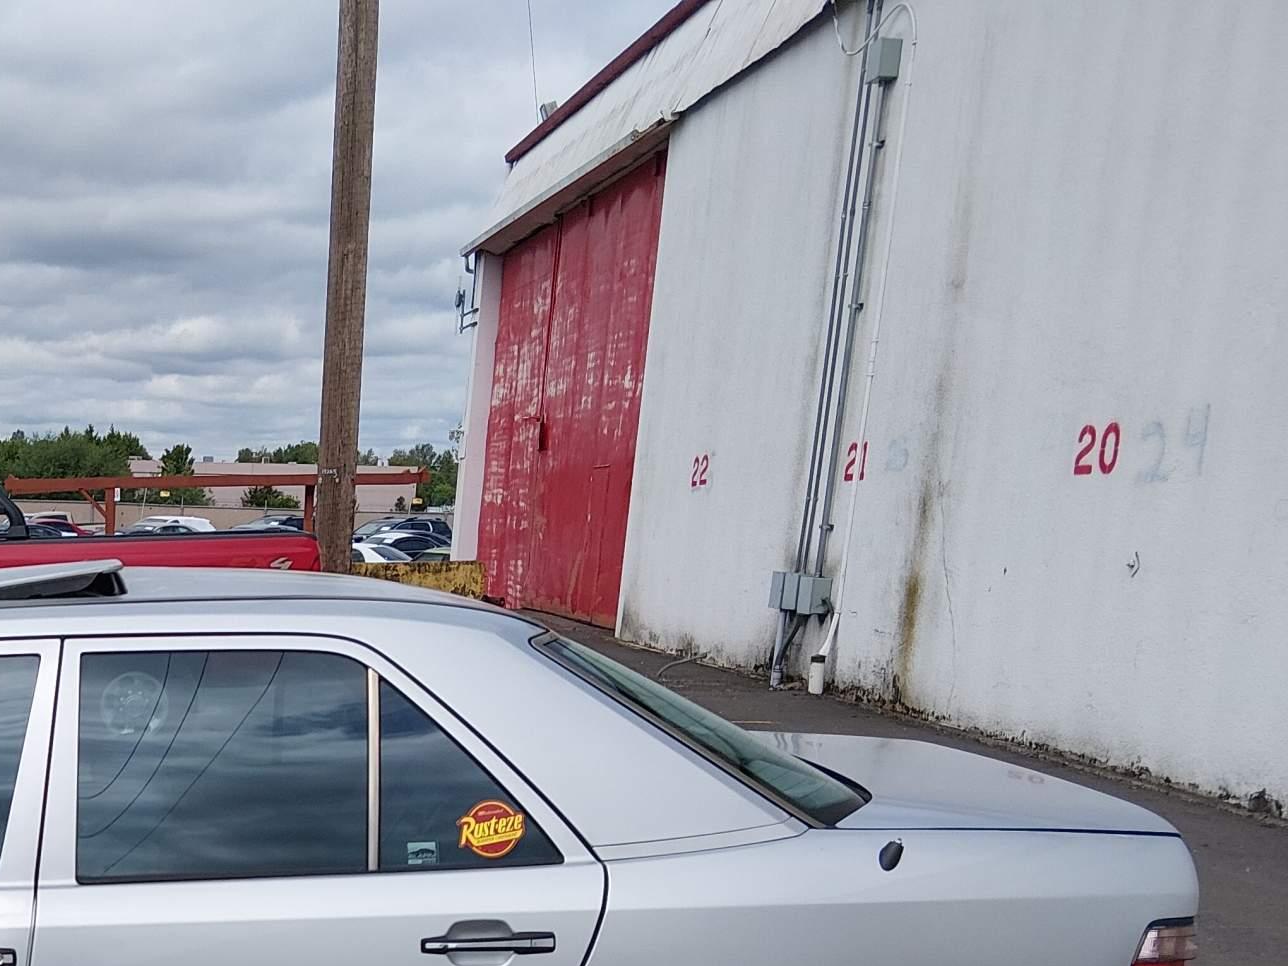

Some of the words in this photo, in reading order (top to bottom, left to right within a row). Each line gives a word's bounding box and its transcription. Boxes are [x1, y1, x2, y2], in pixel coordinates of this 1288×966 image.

[843, 440, 868, 481] 21
[1073, 421, 1121, 475] 20
[691, 453, 710, 487] 22
